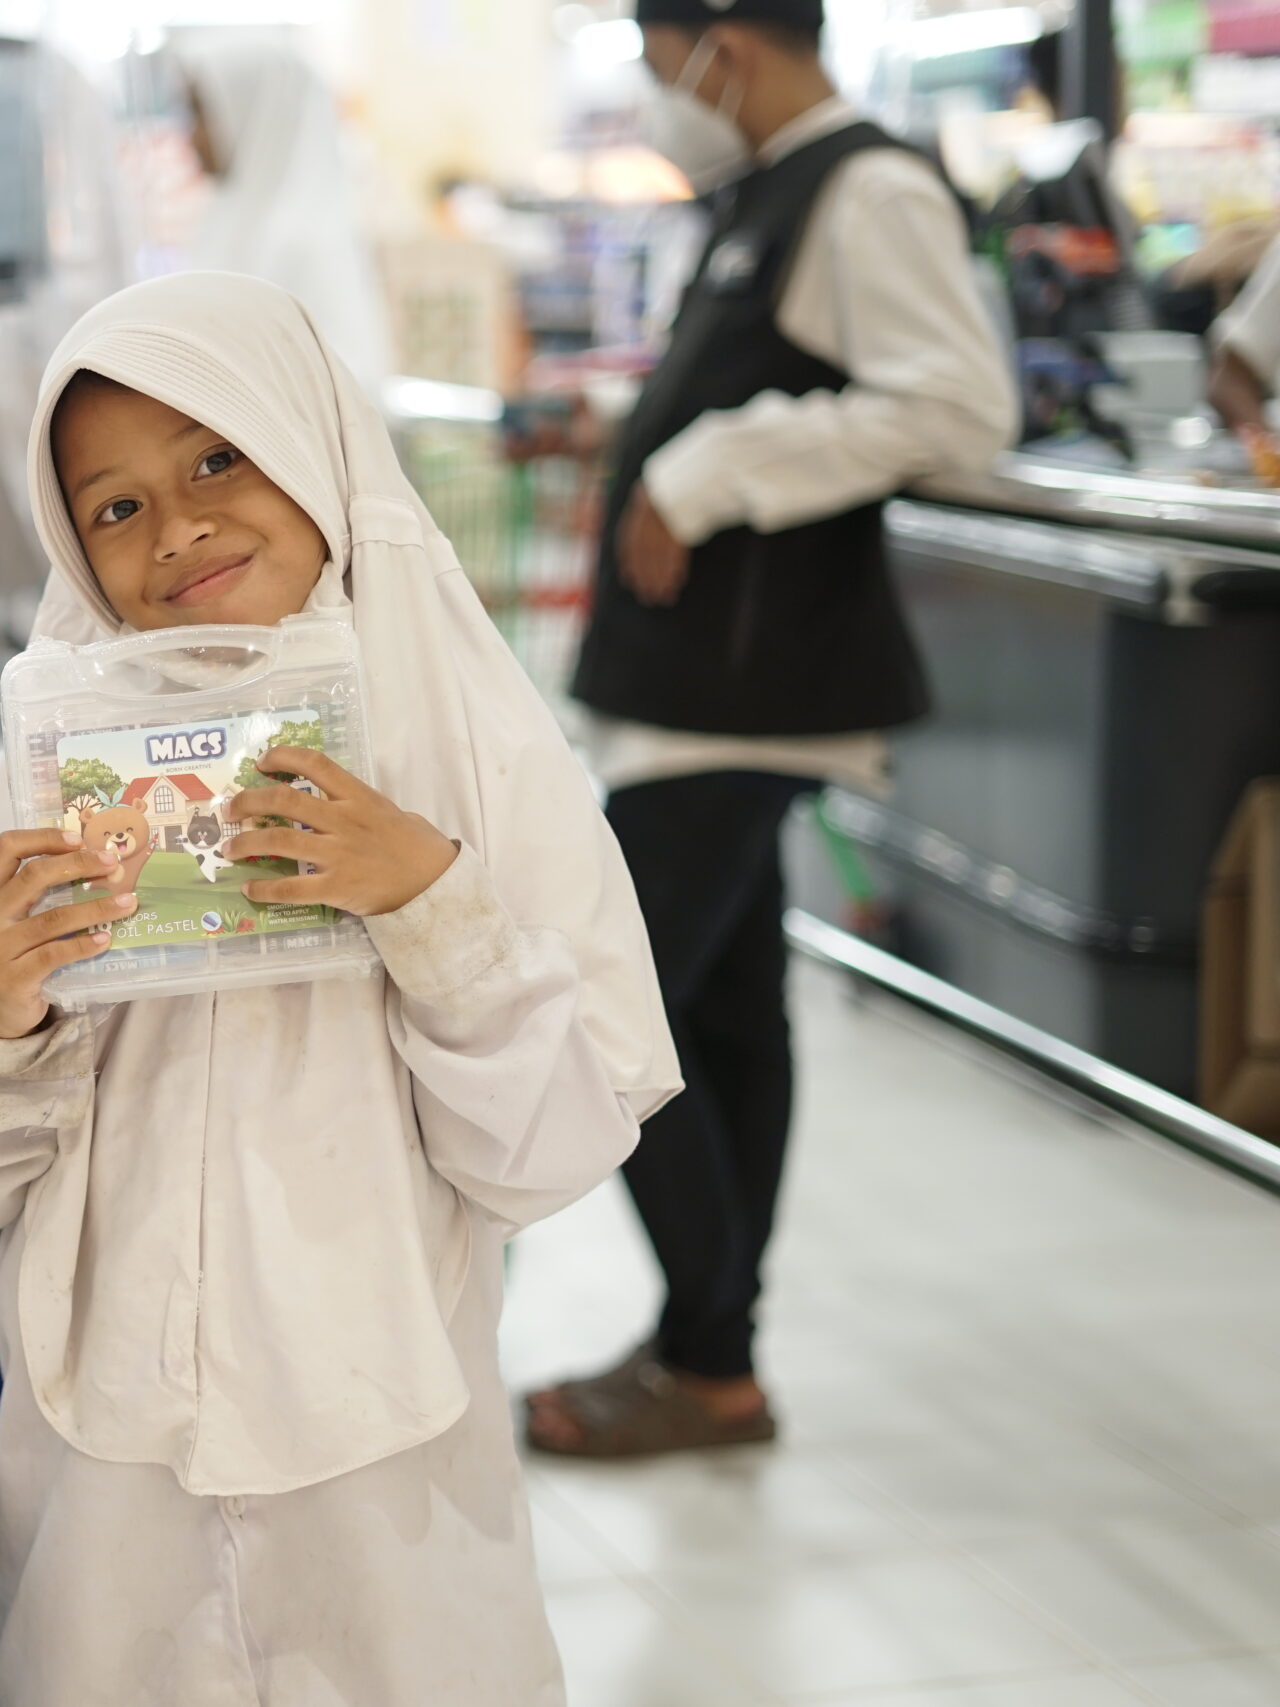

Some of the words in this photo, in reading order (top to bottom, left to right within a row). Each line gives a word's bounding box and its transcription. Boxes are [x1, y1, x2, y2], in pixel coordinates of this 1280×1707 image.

[148, 730, 223, 762] MACS
[289, 914, 319, 922] RESISTANT
[117, 926, 142, 938] OIL
[147, 920, 198, 934] PASTEL
[286, 936, 319, 949] MACS
